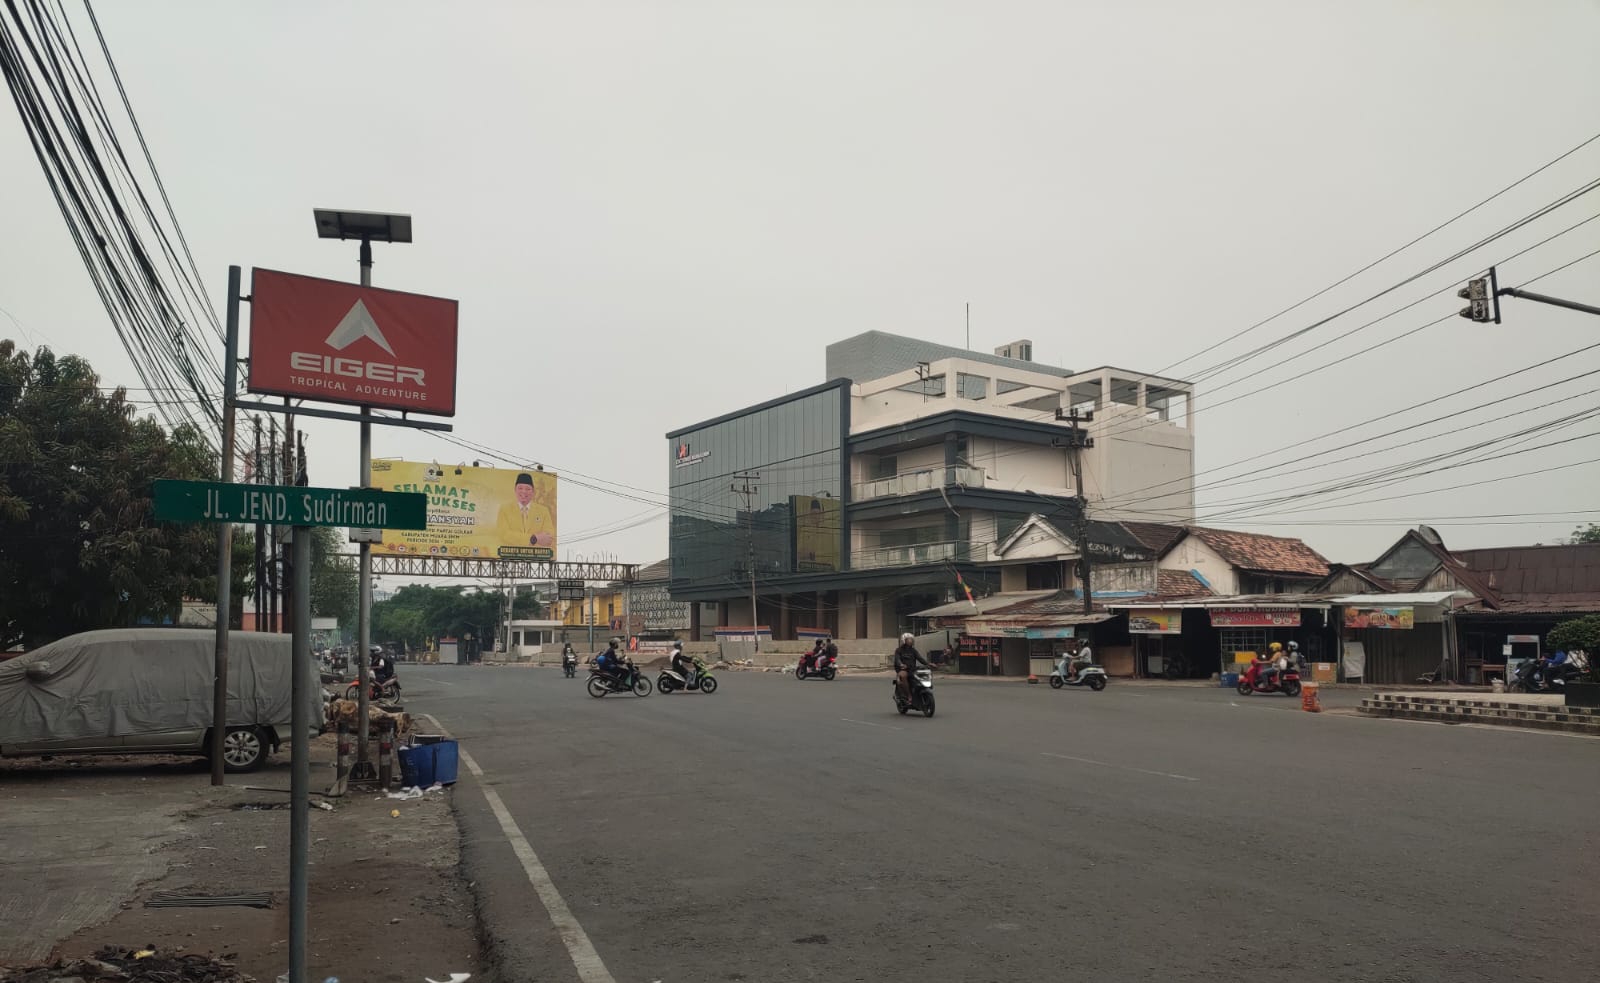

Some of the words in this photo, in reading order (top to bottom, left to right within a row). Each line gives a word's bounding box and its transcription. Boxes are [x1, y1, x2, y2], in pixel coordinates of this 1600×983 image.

[290, 351, 426, 387] EIGER
[289, 375, 348, 392] TROPICAL
[355, 384, 428, 401] ADVENTURE
[393, 483, 470, 499] SELAMAT
[203, 488, 230, 520] JL.
[239, 491, 292, 522] JEND.
[302, 493, 388, 526] Sudirman
